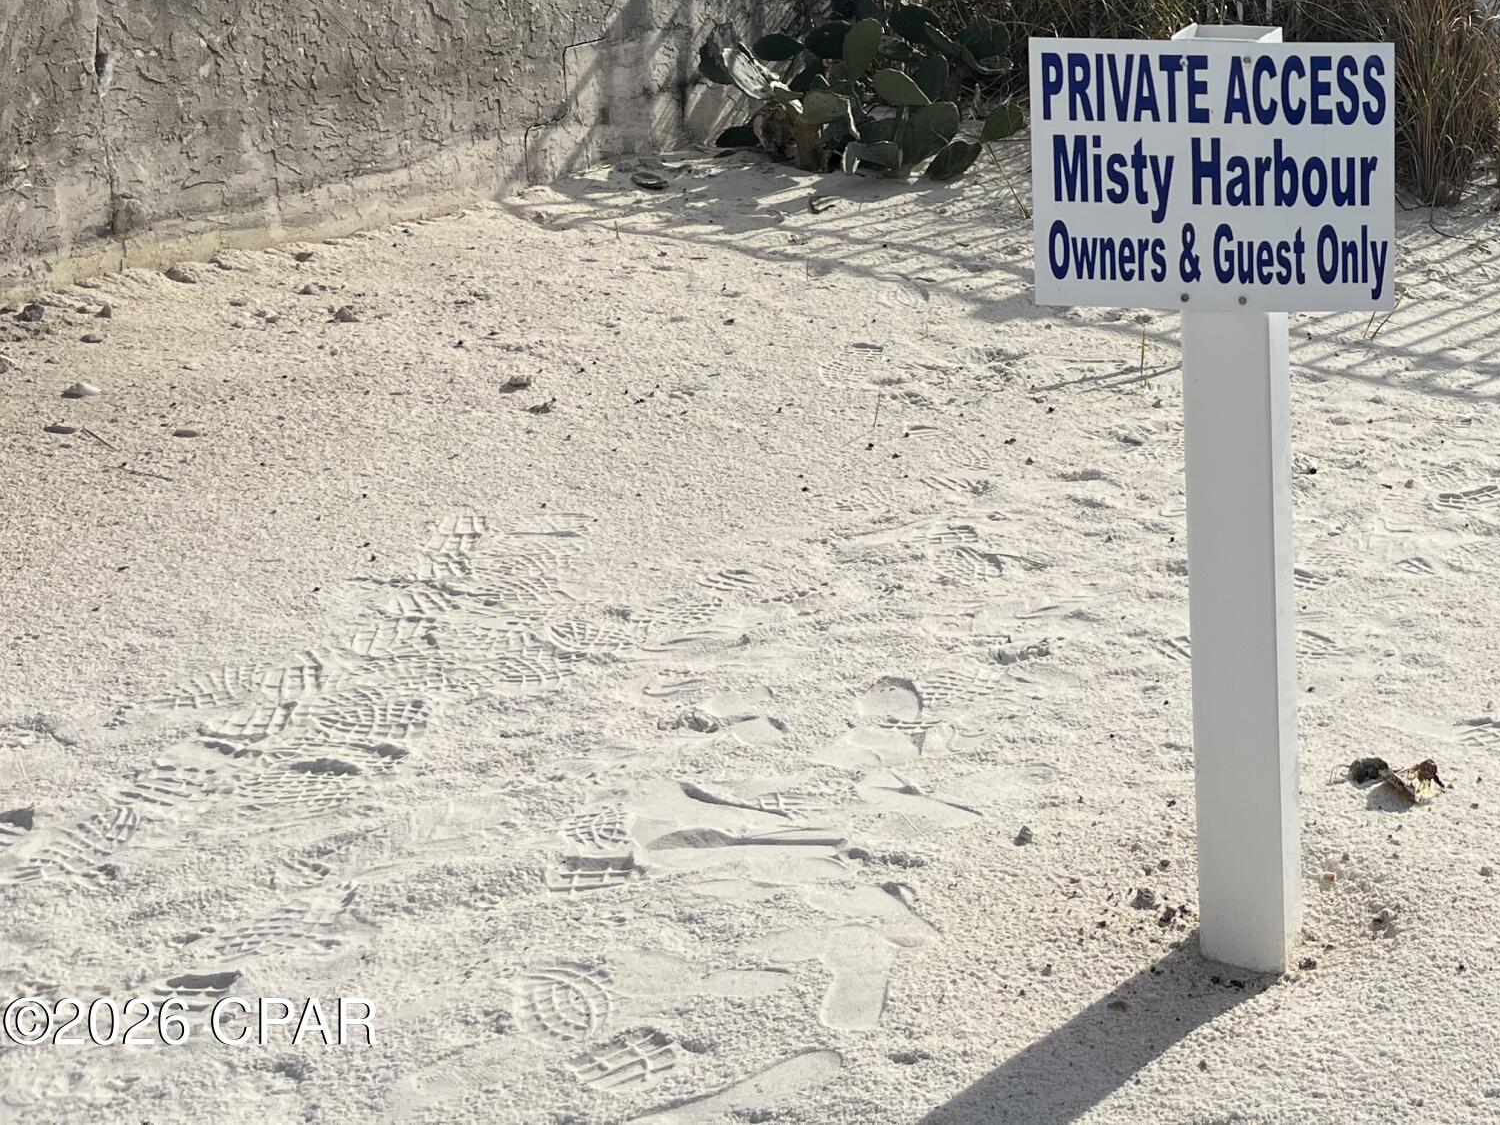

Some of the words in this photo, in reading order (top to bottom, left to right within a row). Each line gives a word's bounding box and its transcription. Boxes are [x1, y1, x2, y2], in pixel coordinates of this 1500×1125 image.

[1041, 52, 1210, 123] PRIVATE
[1224, 55, 1387, 125] ACCESS
[1053, 134, 1175, 224] Misty
[1191, 137, 1378, 207] Harbour
[1048, 220, 1167, 283] Owners
[1179, 222, 1201, 283] &
[1213, 223, 1306, 285] Guest
[1317, 224, 1389, 300] Only
